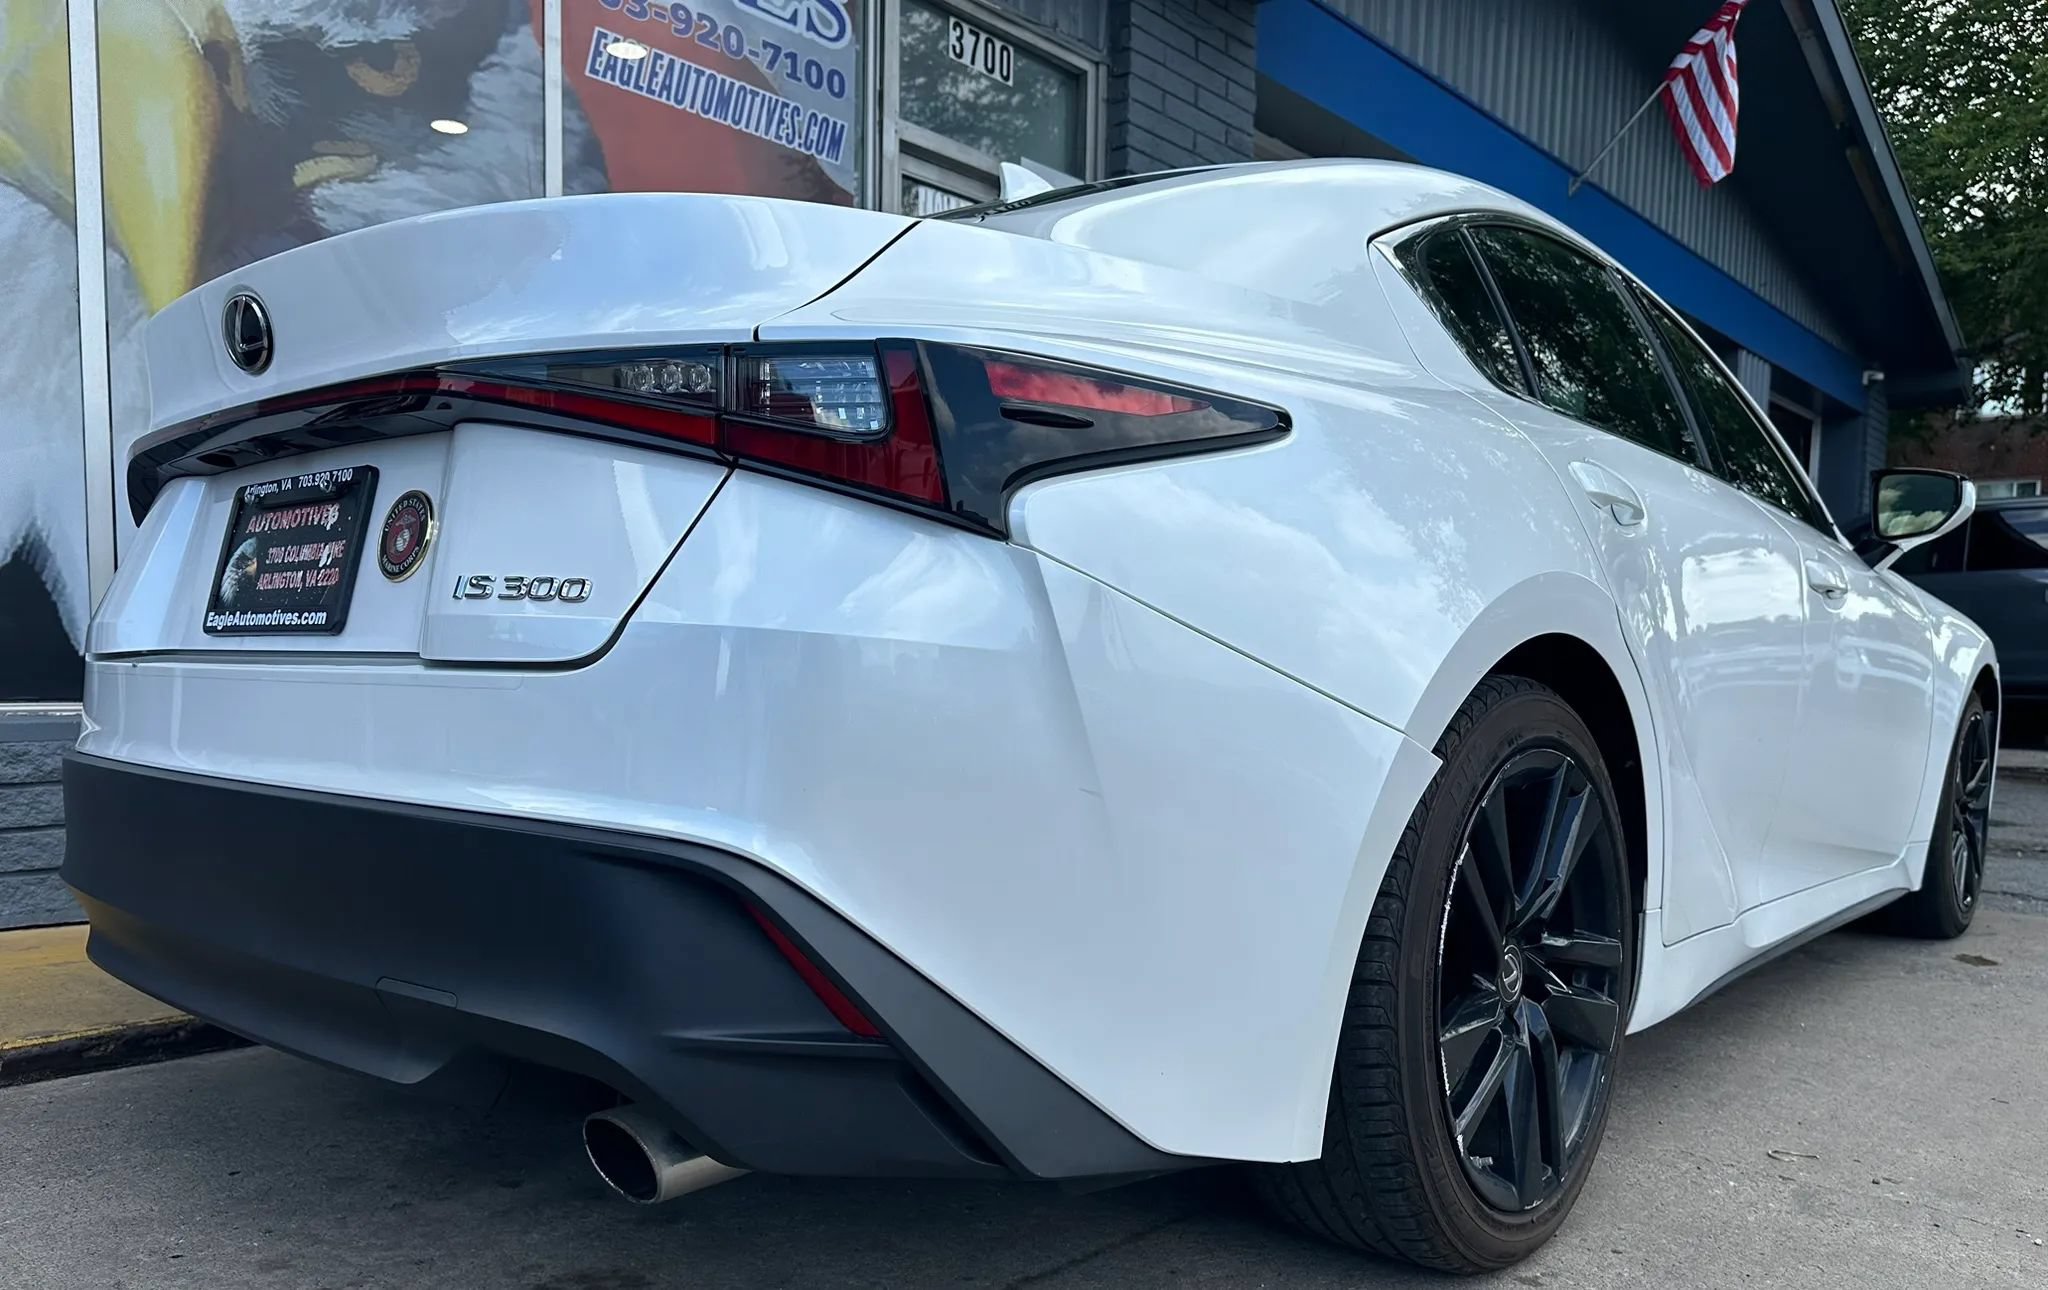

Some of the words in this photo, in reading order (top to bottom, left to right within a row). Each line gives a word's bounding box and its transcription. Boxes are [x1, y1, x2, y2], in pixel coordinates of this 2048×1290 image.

[952, 20, 1011, 82] 3700
[586, 27, 847, 164] EAGLEAUTOMOTIVES.COM
[281, 478, 292, 491] VA
[385, 500, 408, 532] UNITED
[409, 498, 426, 521] STATES
[382, 554, 400, 572] MARINE
[305, 569, 318, 587] VA
[452, 575, 497, 600] IS
[498, 575, 593, 603] 300
[206, 609, 327, 630] EagleAutomotives.com
